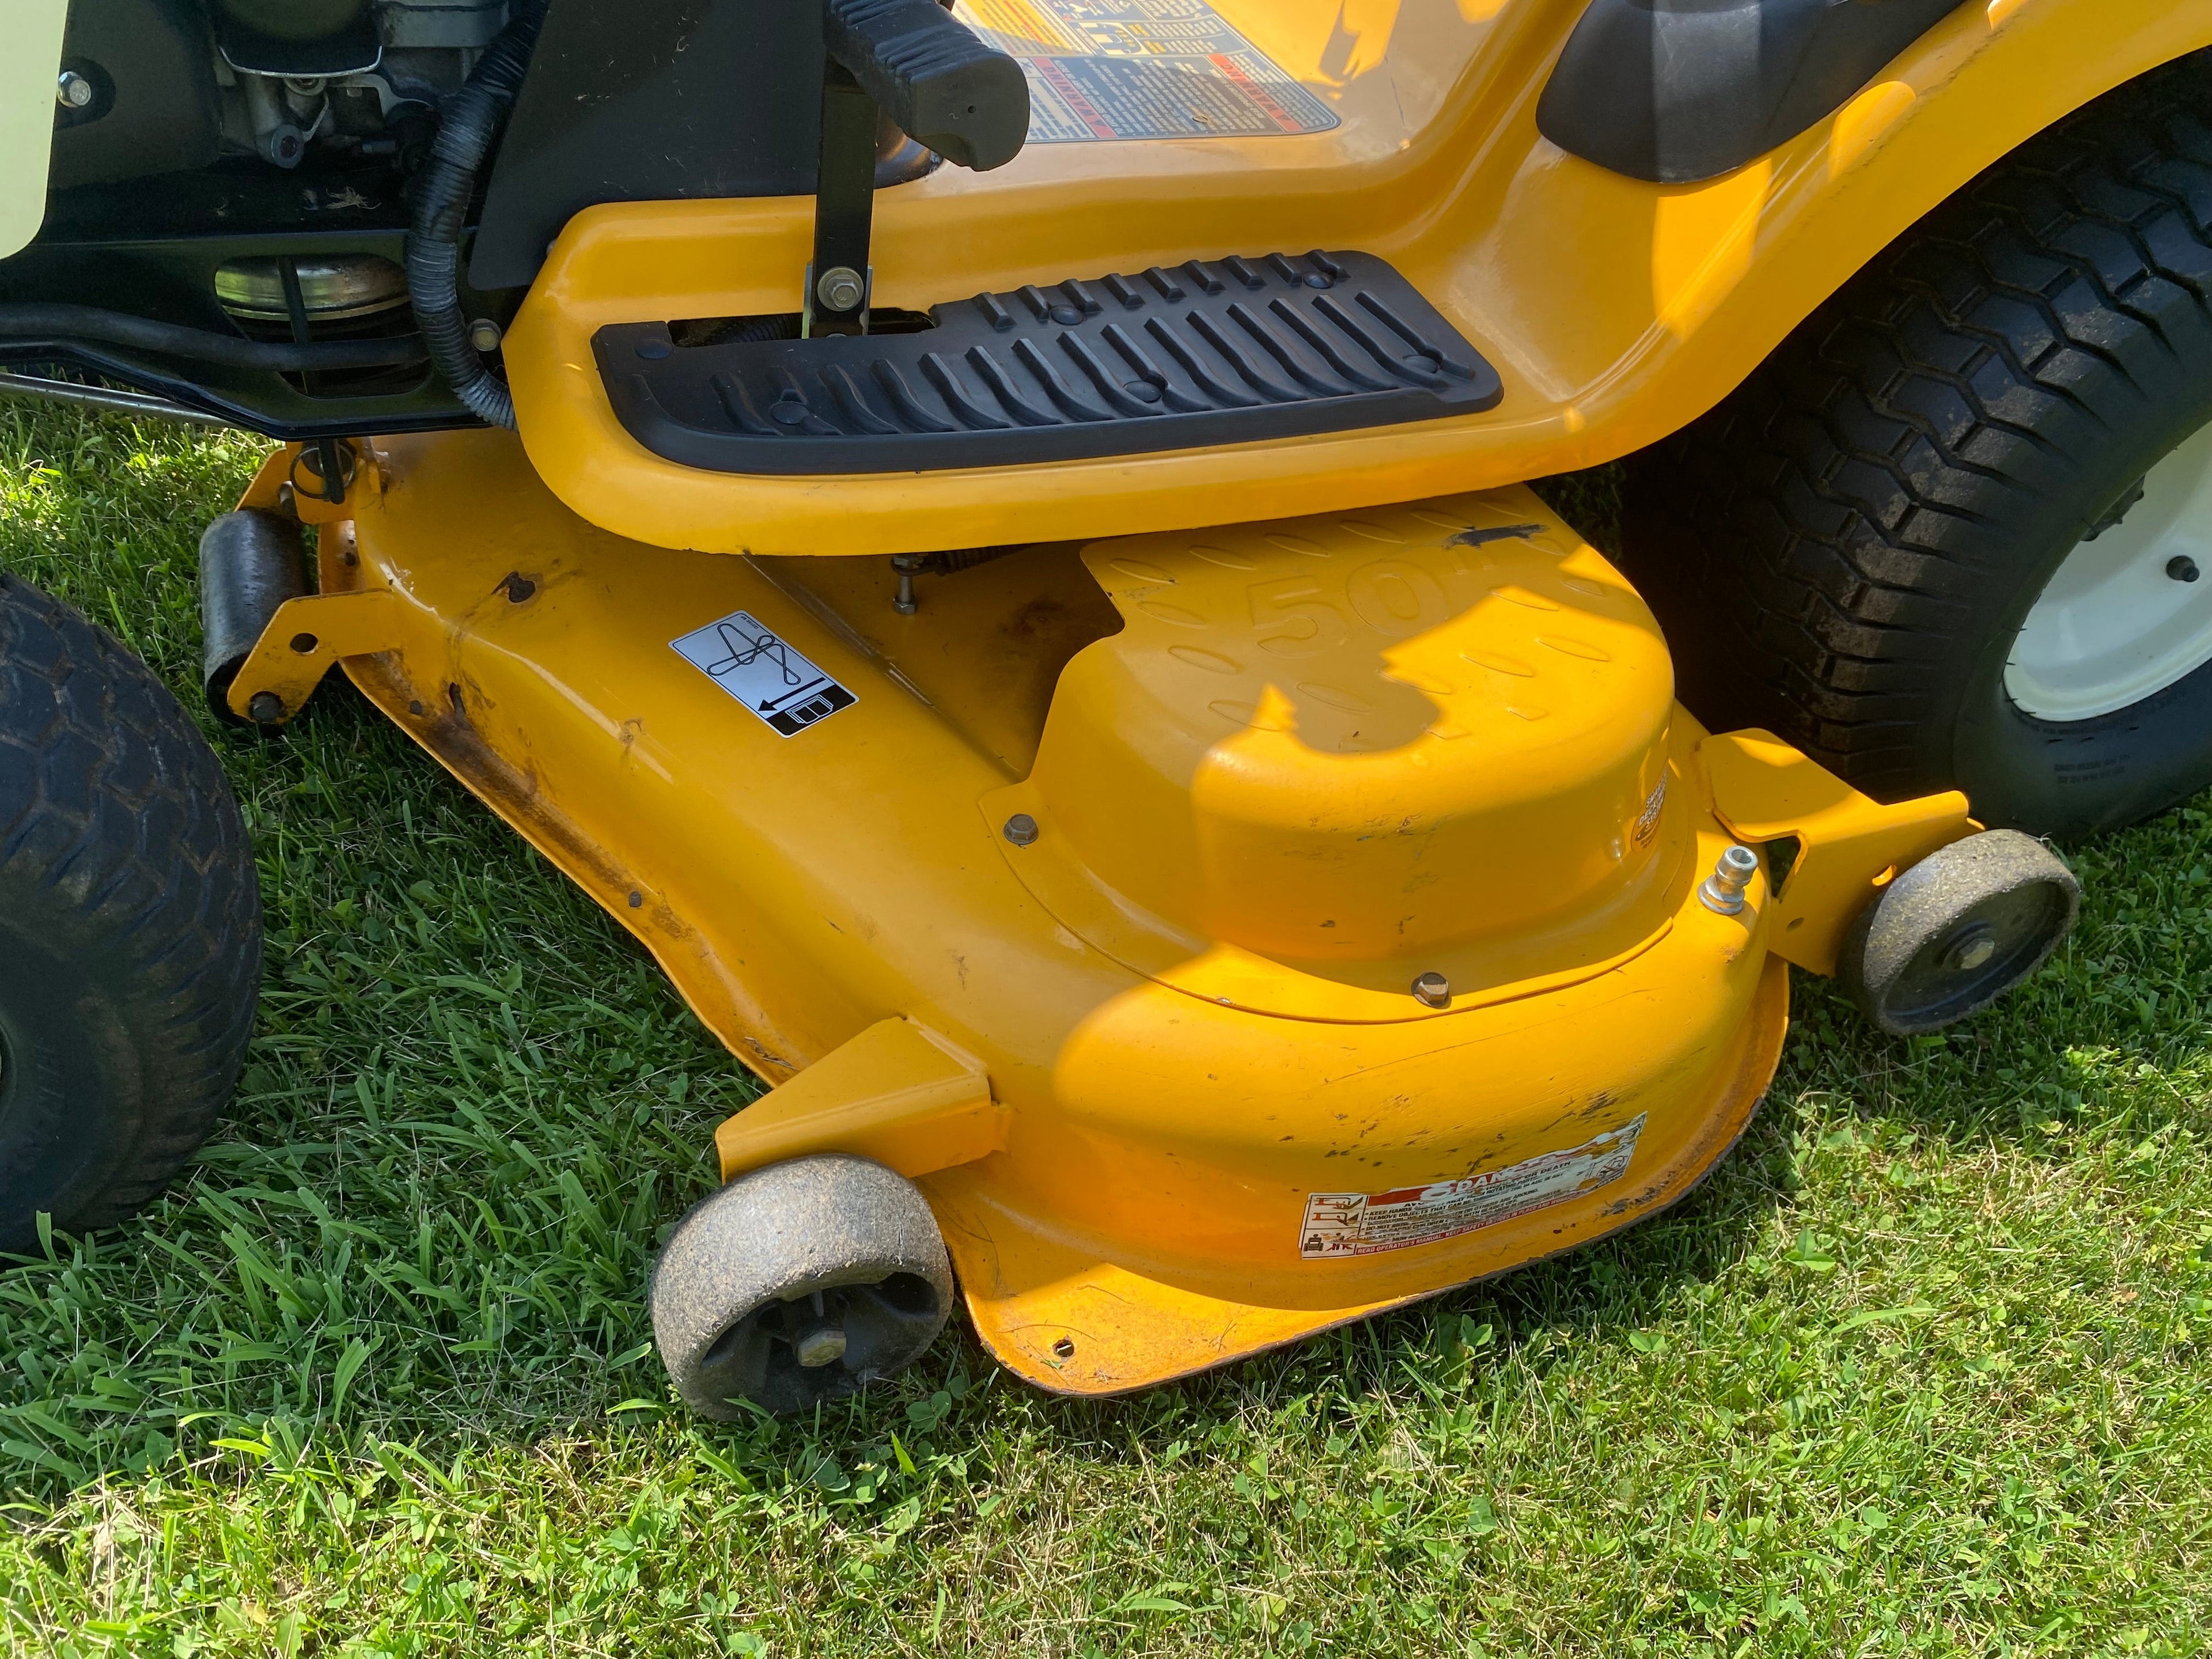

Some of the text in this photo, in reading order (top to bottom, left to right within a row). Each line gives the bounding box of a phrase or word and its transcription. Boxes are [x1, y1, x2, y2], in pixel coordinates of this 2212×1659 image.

[1041, 67, 1096, 115] WARNING
[1221, 65, 1278, 109] WARNING
[1541, 1161, 1570, 1173] DEATH
[1389, 1206, 1411, 1214] HANDS
[1474, 1200, 1498, 1210] OTHERS
[1513, 1188, 1537, 1199] AROUND.
[1368, 1213, 1396, 1221] REMOVE
[1399, 1208, 1427, 1217] OBJECTS
[1377, 1240, 1414, 1251] OPERATOR'S
[1416, 1234, 1443, 1244] MANUAL.
[1463, 1221, 1484, 1232] SAFETY
[1517, 1205, 1536, 1215] PLACE
